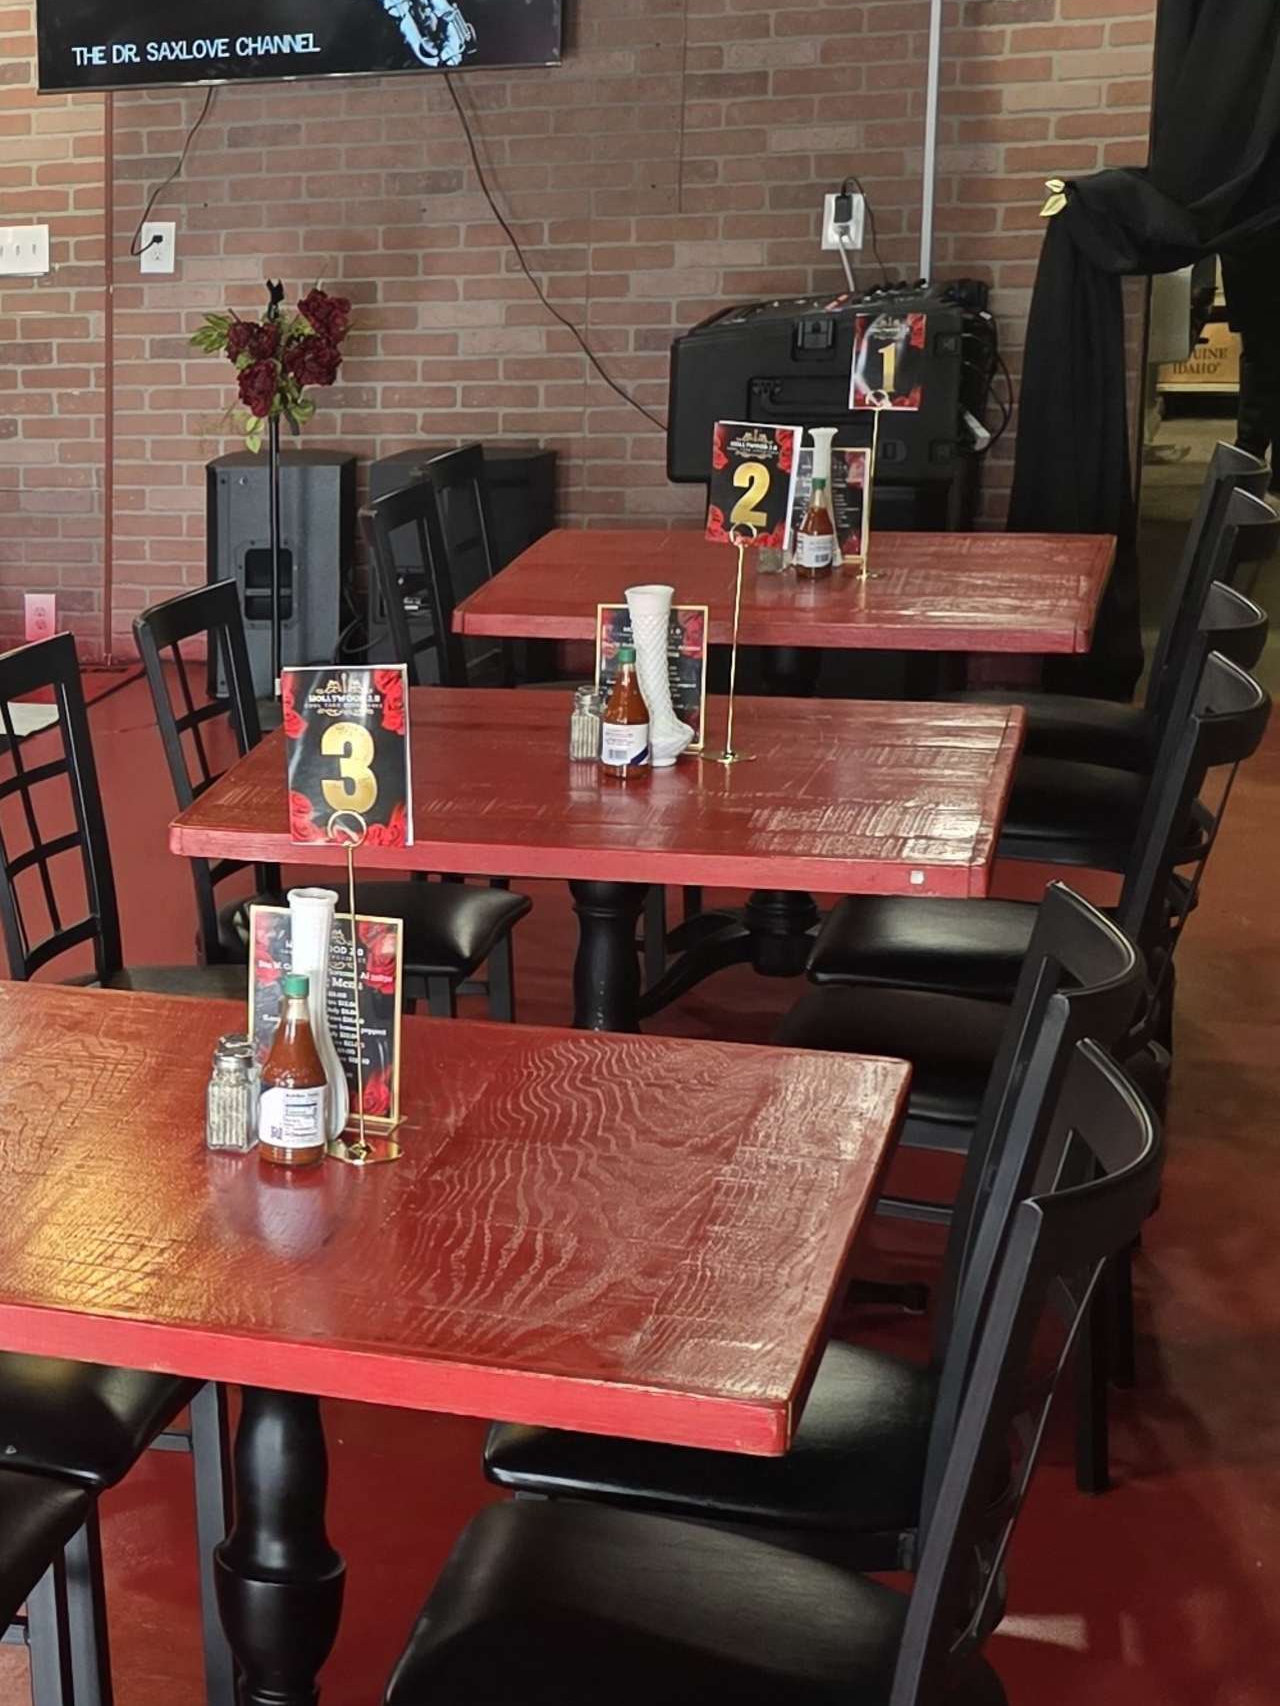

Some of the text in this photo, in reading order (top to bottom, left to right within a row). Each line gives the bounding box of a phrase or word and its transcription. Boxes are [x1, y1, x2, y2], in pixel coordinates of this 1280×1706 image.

[72, 33, 321, 67] THE DR. SAXLOVE CHANNEL
[878, 343, 896, 392] 1
[730, 461, 770, 527] 2
[321, 722, 378, 813] 3
